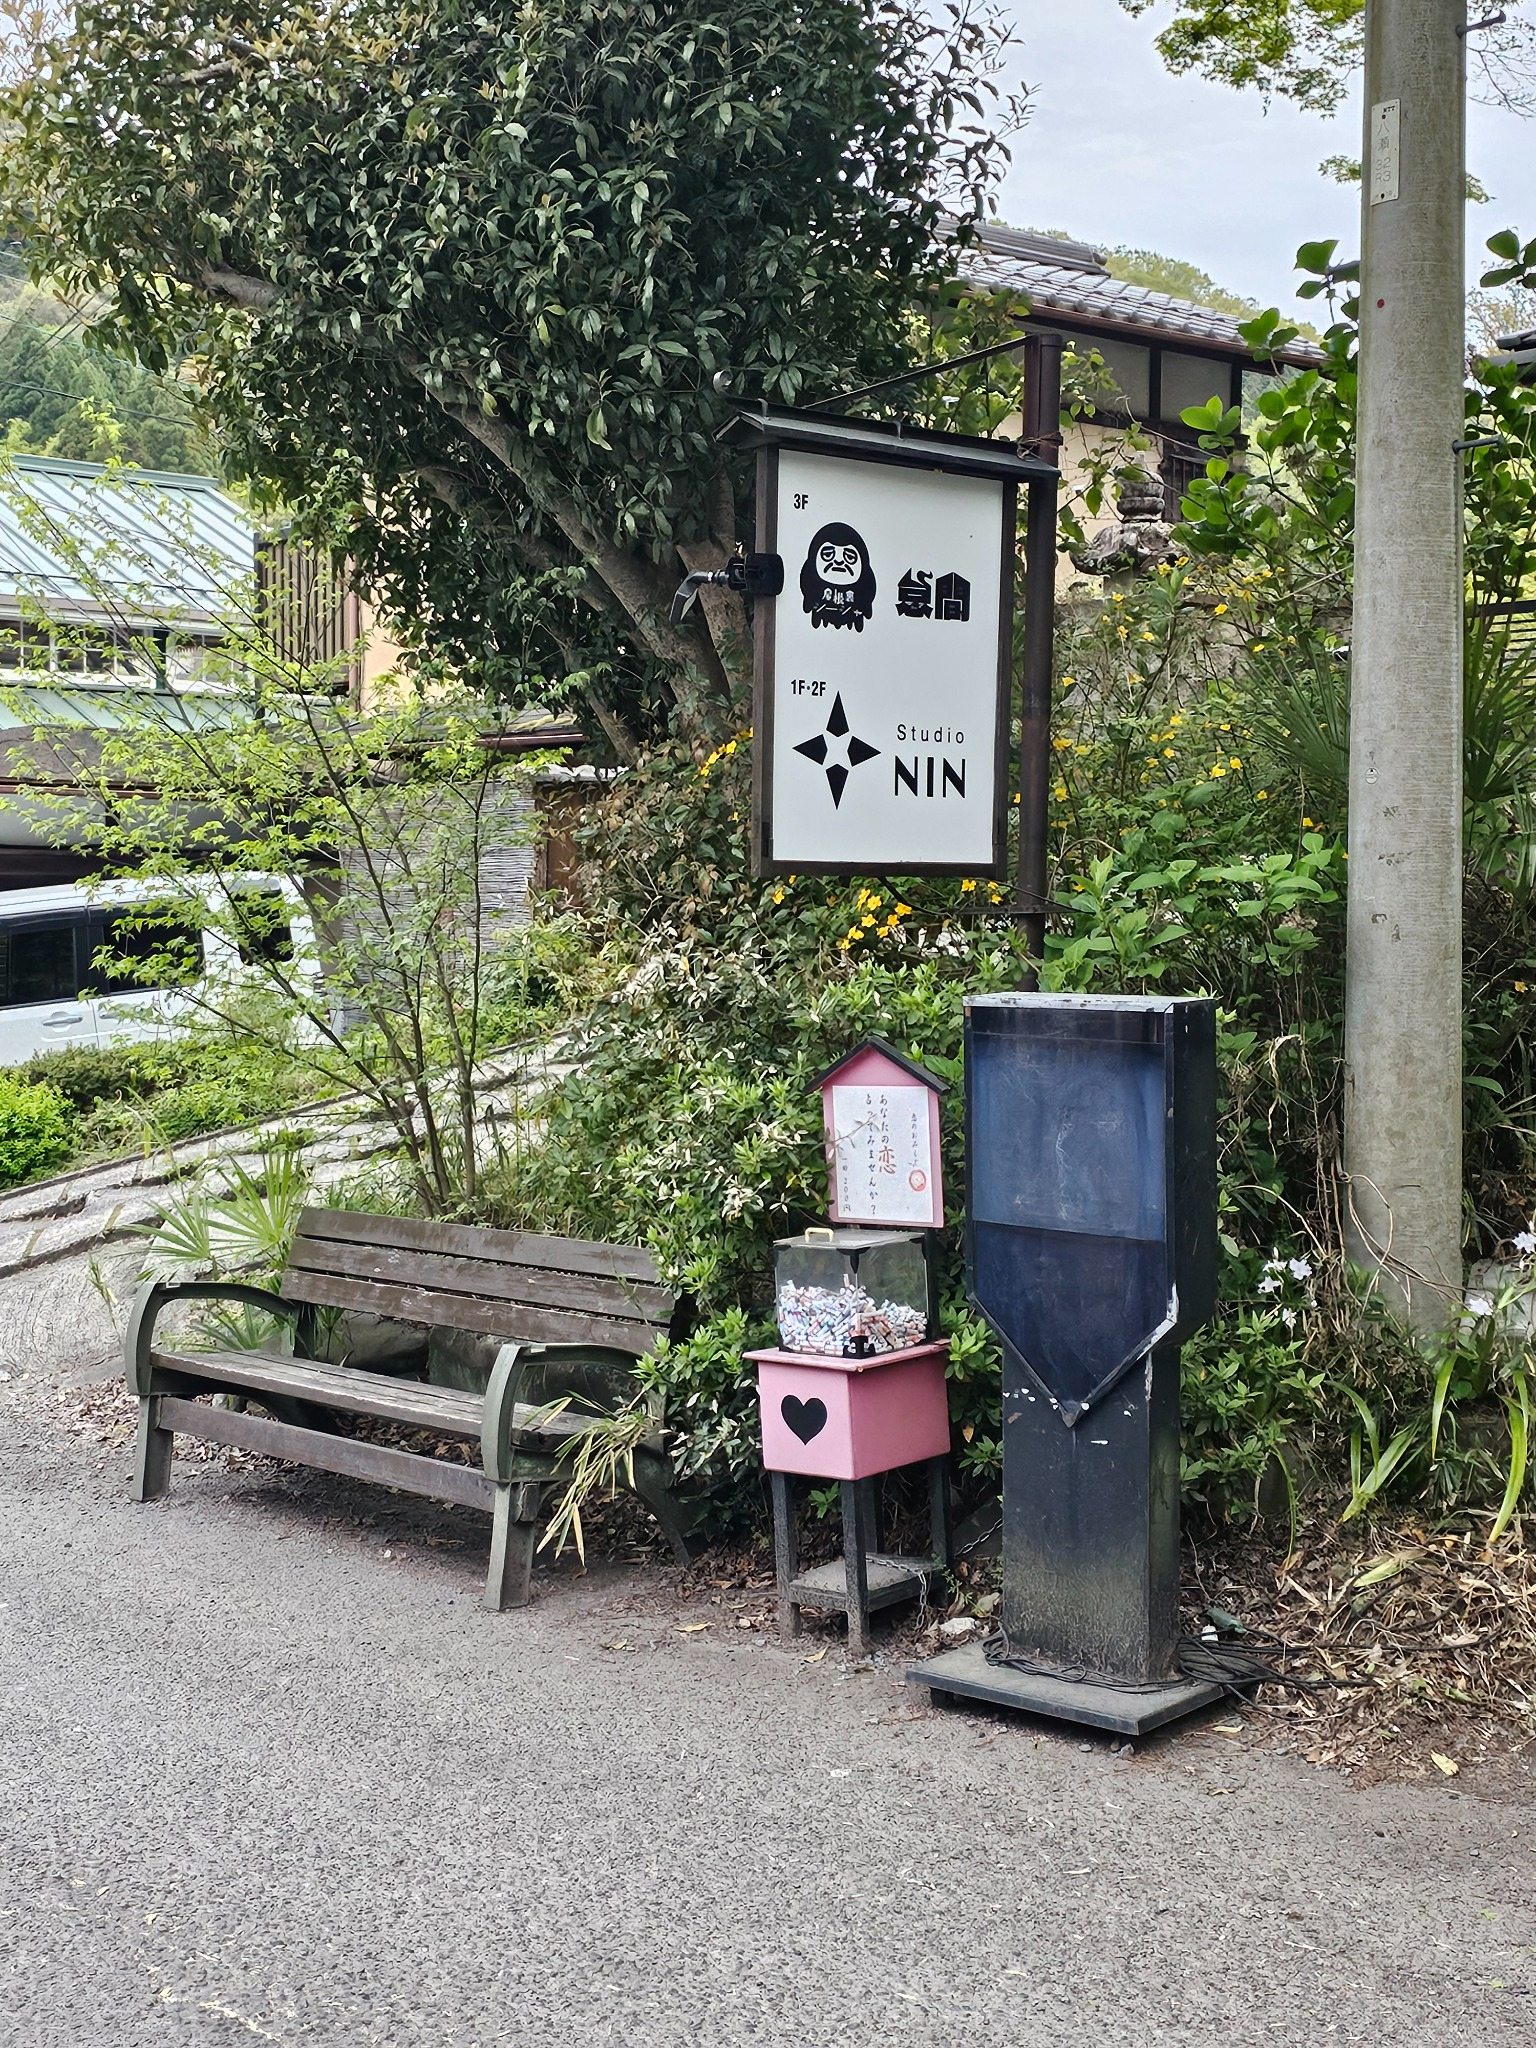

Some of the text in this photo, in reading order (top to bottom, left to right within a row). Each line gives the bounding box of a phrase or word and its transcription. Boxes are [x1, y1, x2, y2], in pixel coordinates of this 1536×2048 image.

[793, 493, 809, 510] 3F
[896, 723, 965, 744] Studio
[894, 755, 966, 799] NIN
